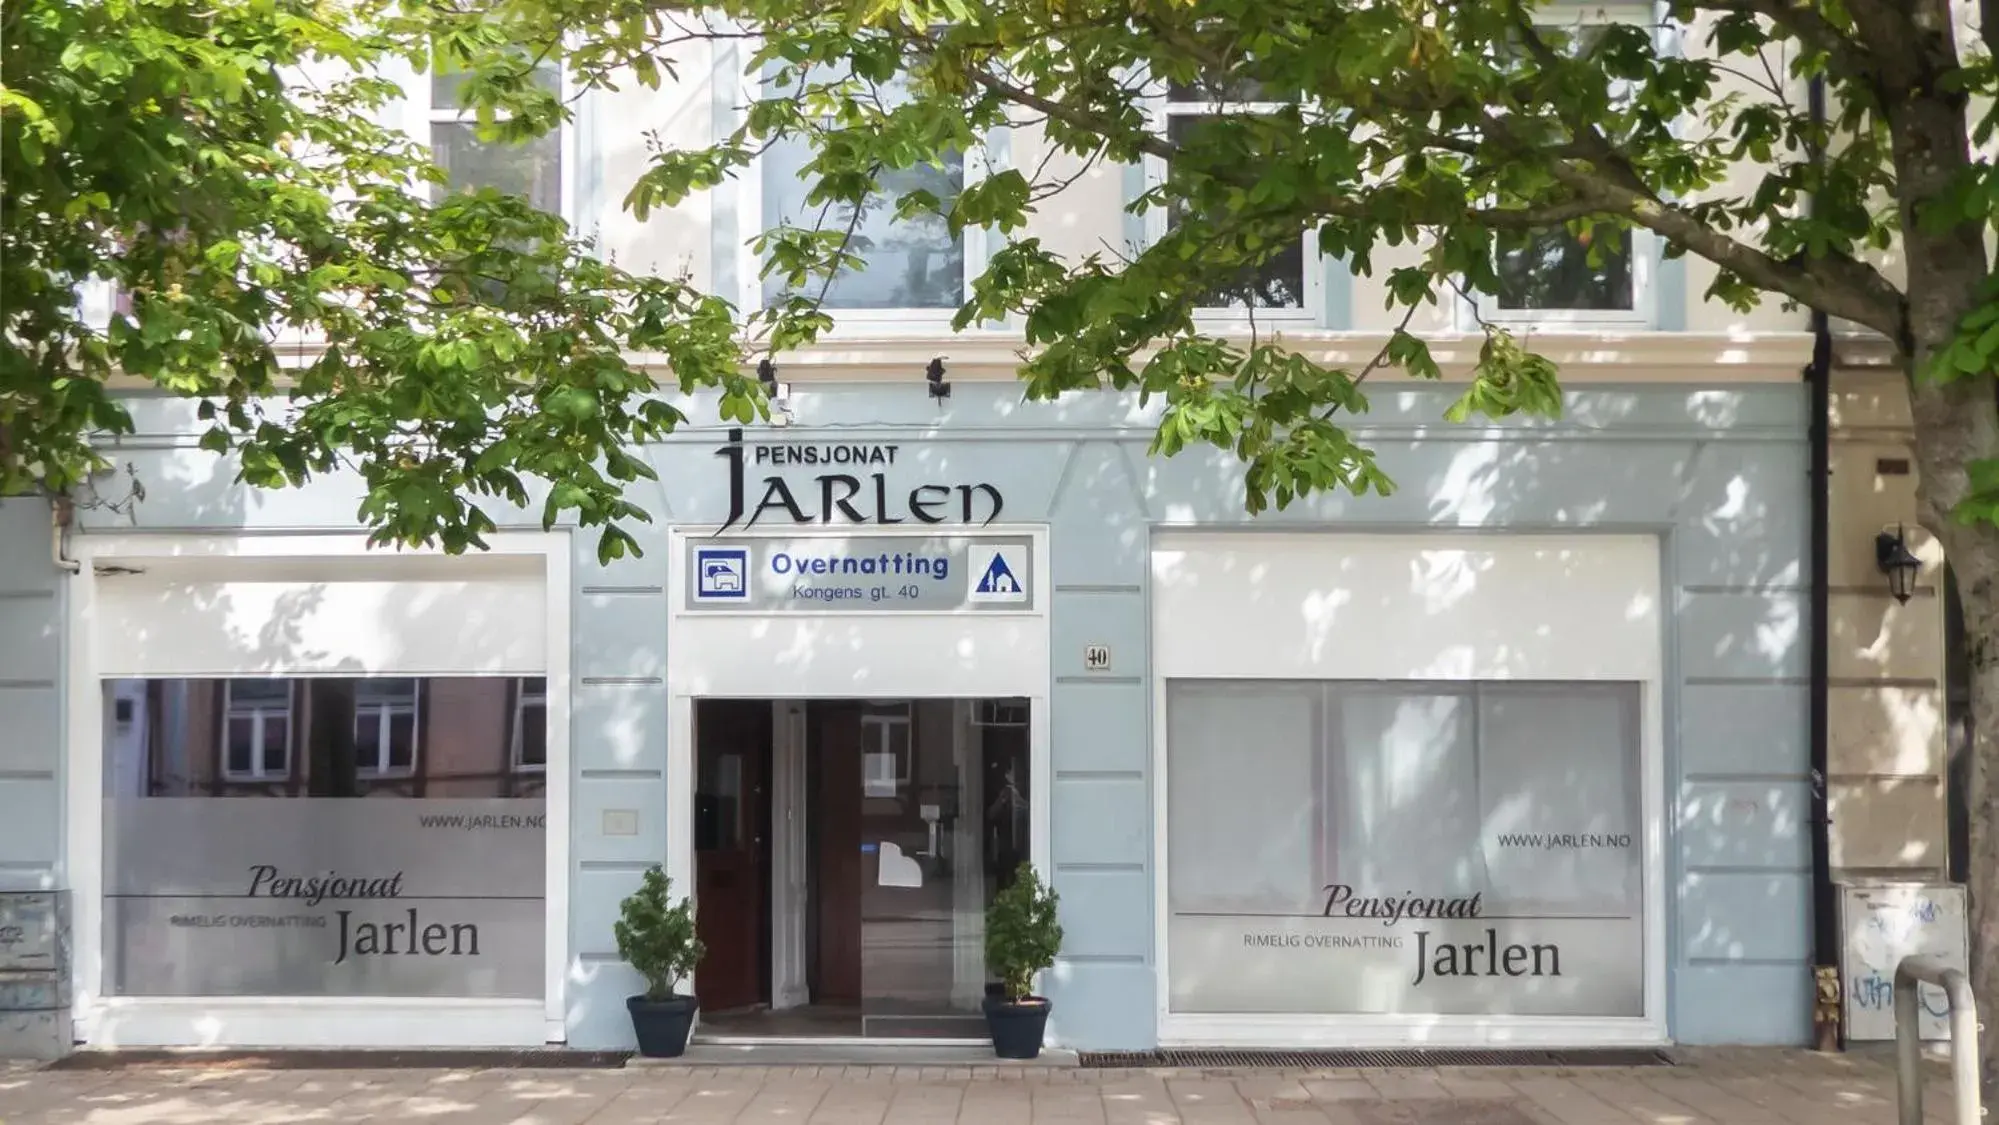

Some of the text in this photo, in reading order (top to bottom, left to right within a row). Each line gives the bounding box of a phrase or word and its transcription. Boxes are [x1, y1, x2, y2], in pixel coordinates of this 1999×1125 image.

[755, 445, 899, 465] PENSJONAT
[771, 553, 948, 580] Overnatting
[793, 585, 862, 601] Kongens
[898, 585, 919, 599] 40
[1088, 648, 1107, 665] 40
[1497, 833, 1631, 851] WWW.JARLEN.NO
[247, 864, 404, 907] Pensjonat
[1322, 884, 1482, 926] Pensjonat
[229, 915, 327, 929] OVERNATTING
[334, 907, 481, 966] Jarlen
[1243, 934, 1404, 949] RIMELIG OVERNATTING
[1412, 928, 1561, 986] Jarlen
